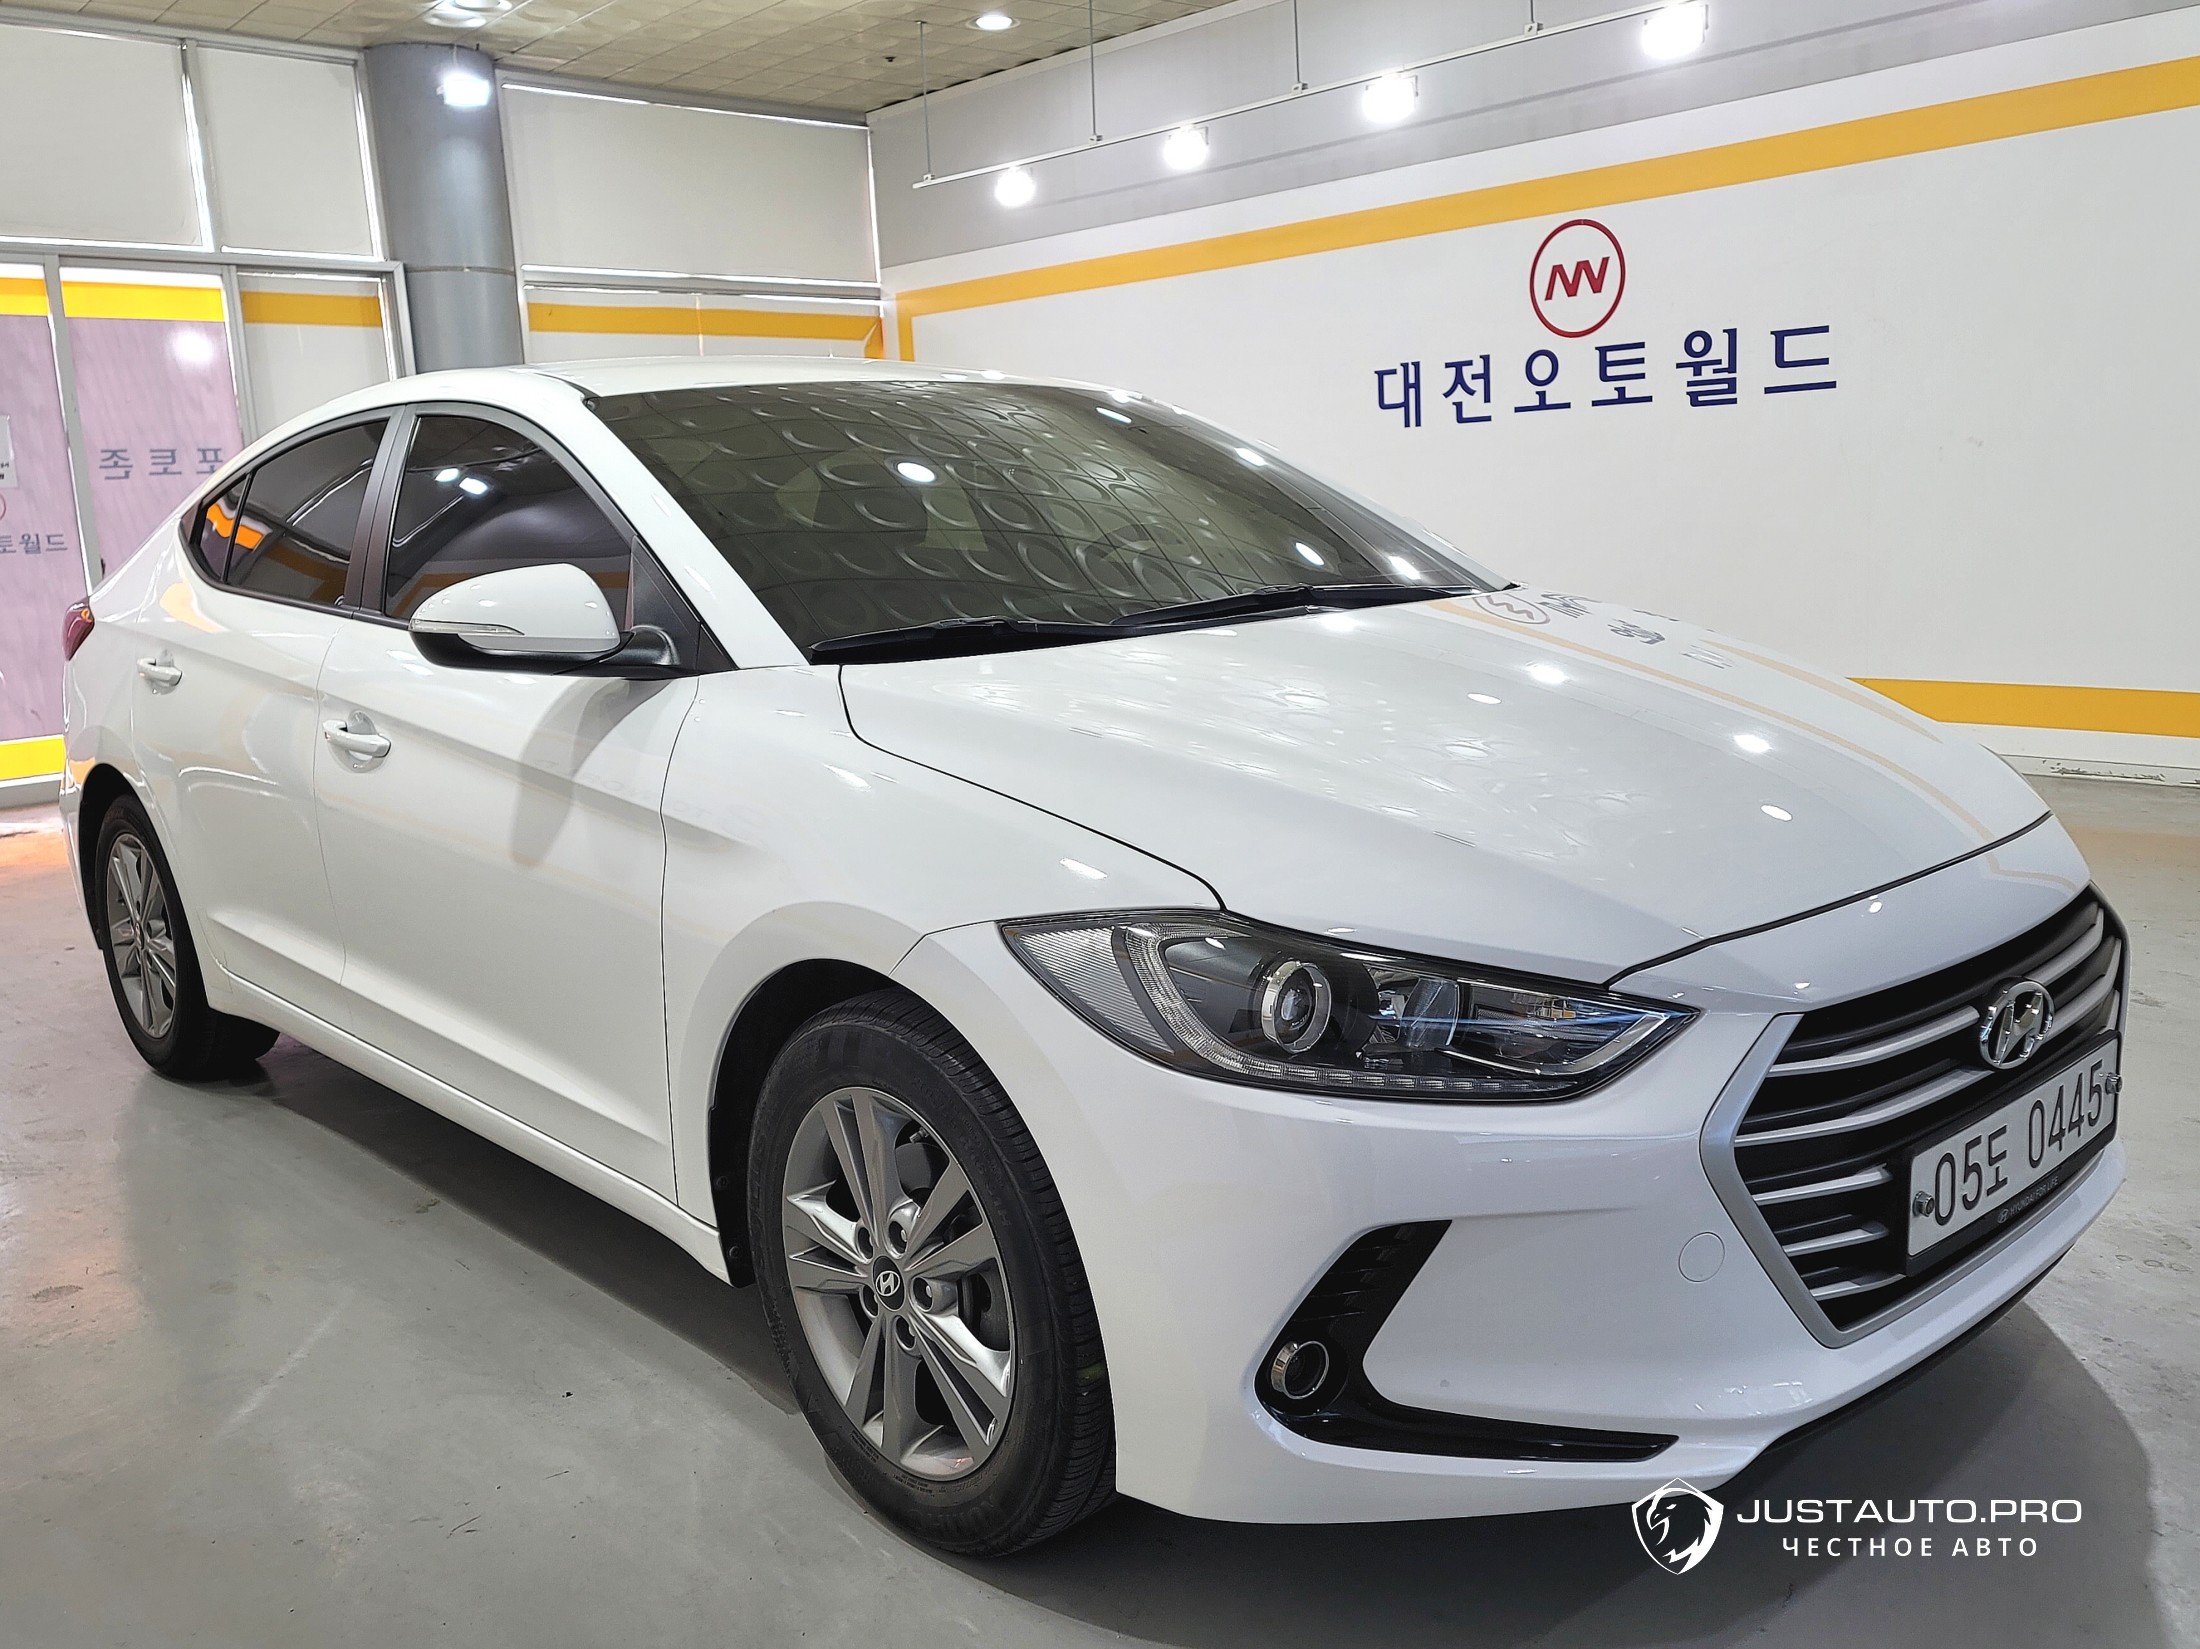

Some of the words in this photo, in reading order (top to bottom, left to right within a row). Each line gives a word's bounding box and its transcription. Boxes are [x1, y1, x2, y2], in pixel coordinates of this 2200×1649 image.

[1374, 324, 1837, 429] 대전오토월드
[1934, 1124, 2008, 1226] 05도
[2028, 1059, 2104, 1169] 0445
